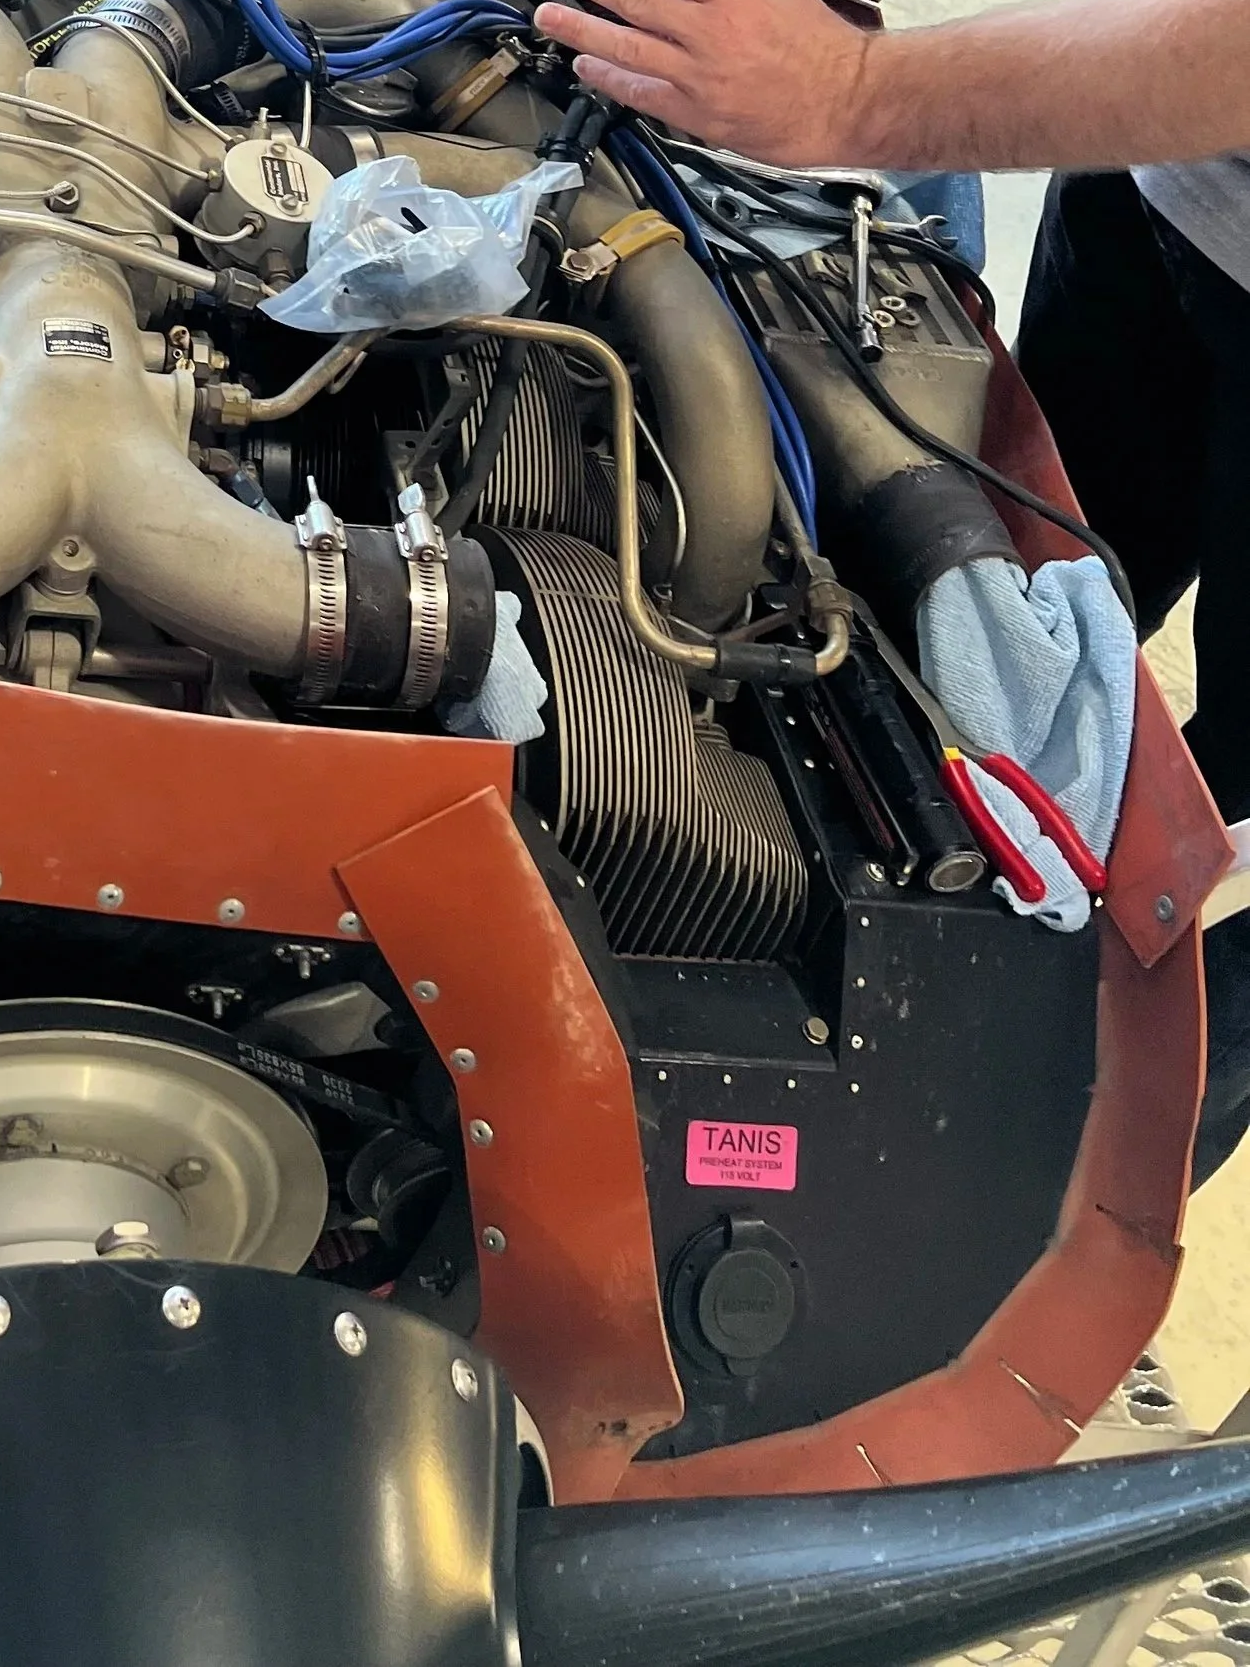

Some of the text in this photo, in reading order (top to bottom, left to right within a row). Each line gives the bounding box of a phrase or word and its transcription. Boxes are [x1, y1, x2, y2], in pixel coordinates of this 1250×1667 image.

[703, 1127, 781, 1155] TANIS
[699, 1157, 783, 1170] PREHEAT SYSTEM
[736, 1171, 761, 1182] VOLT
